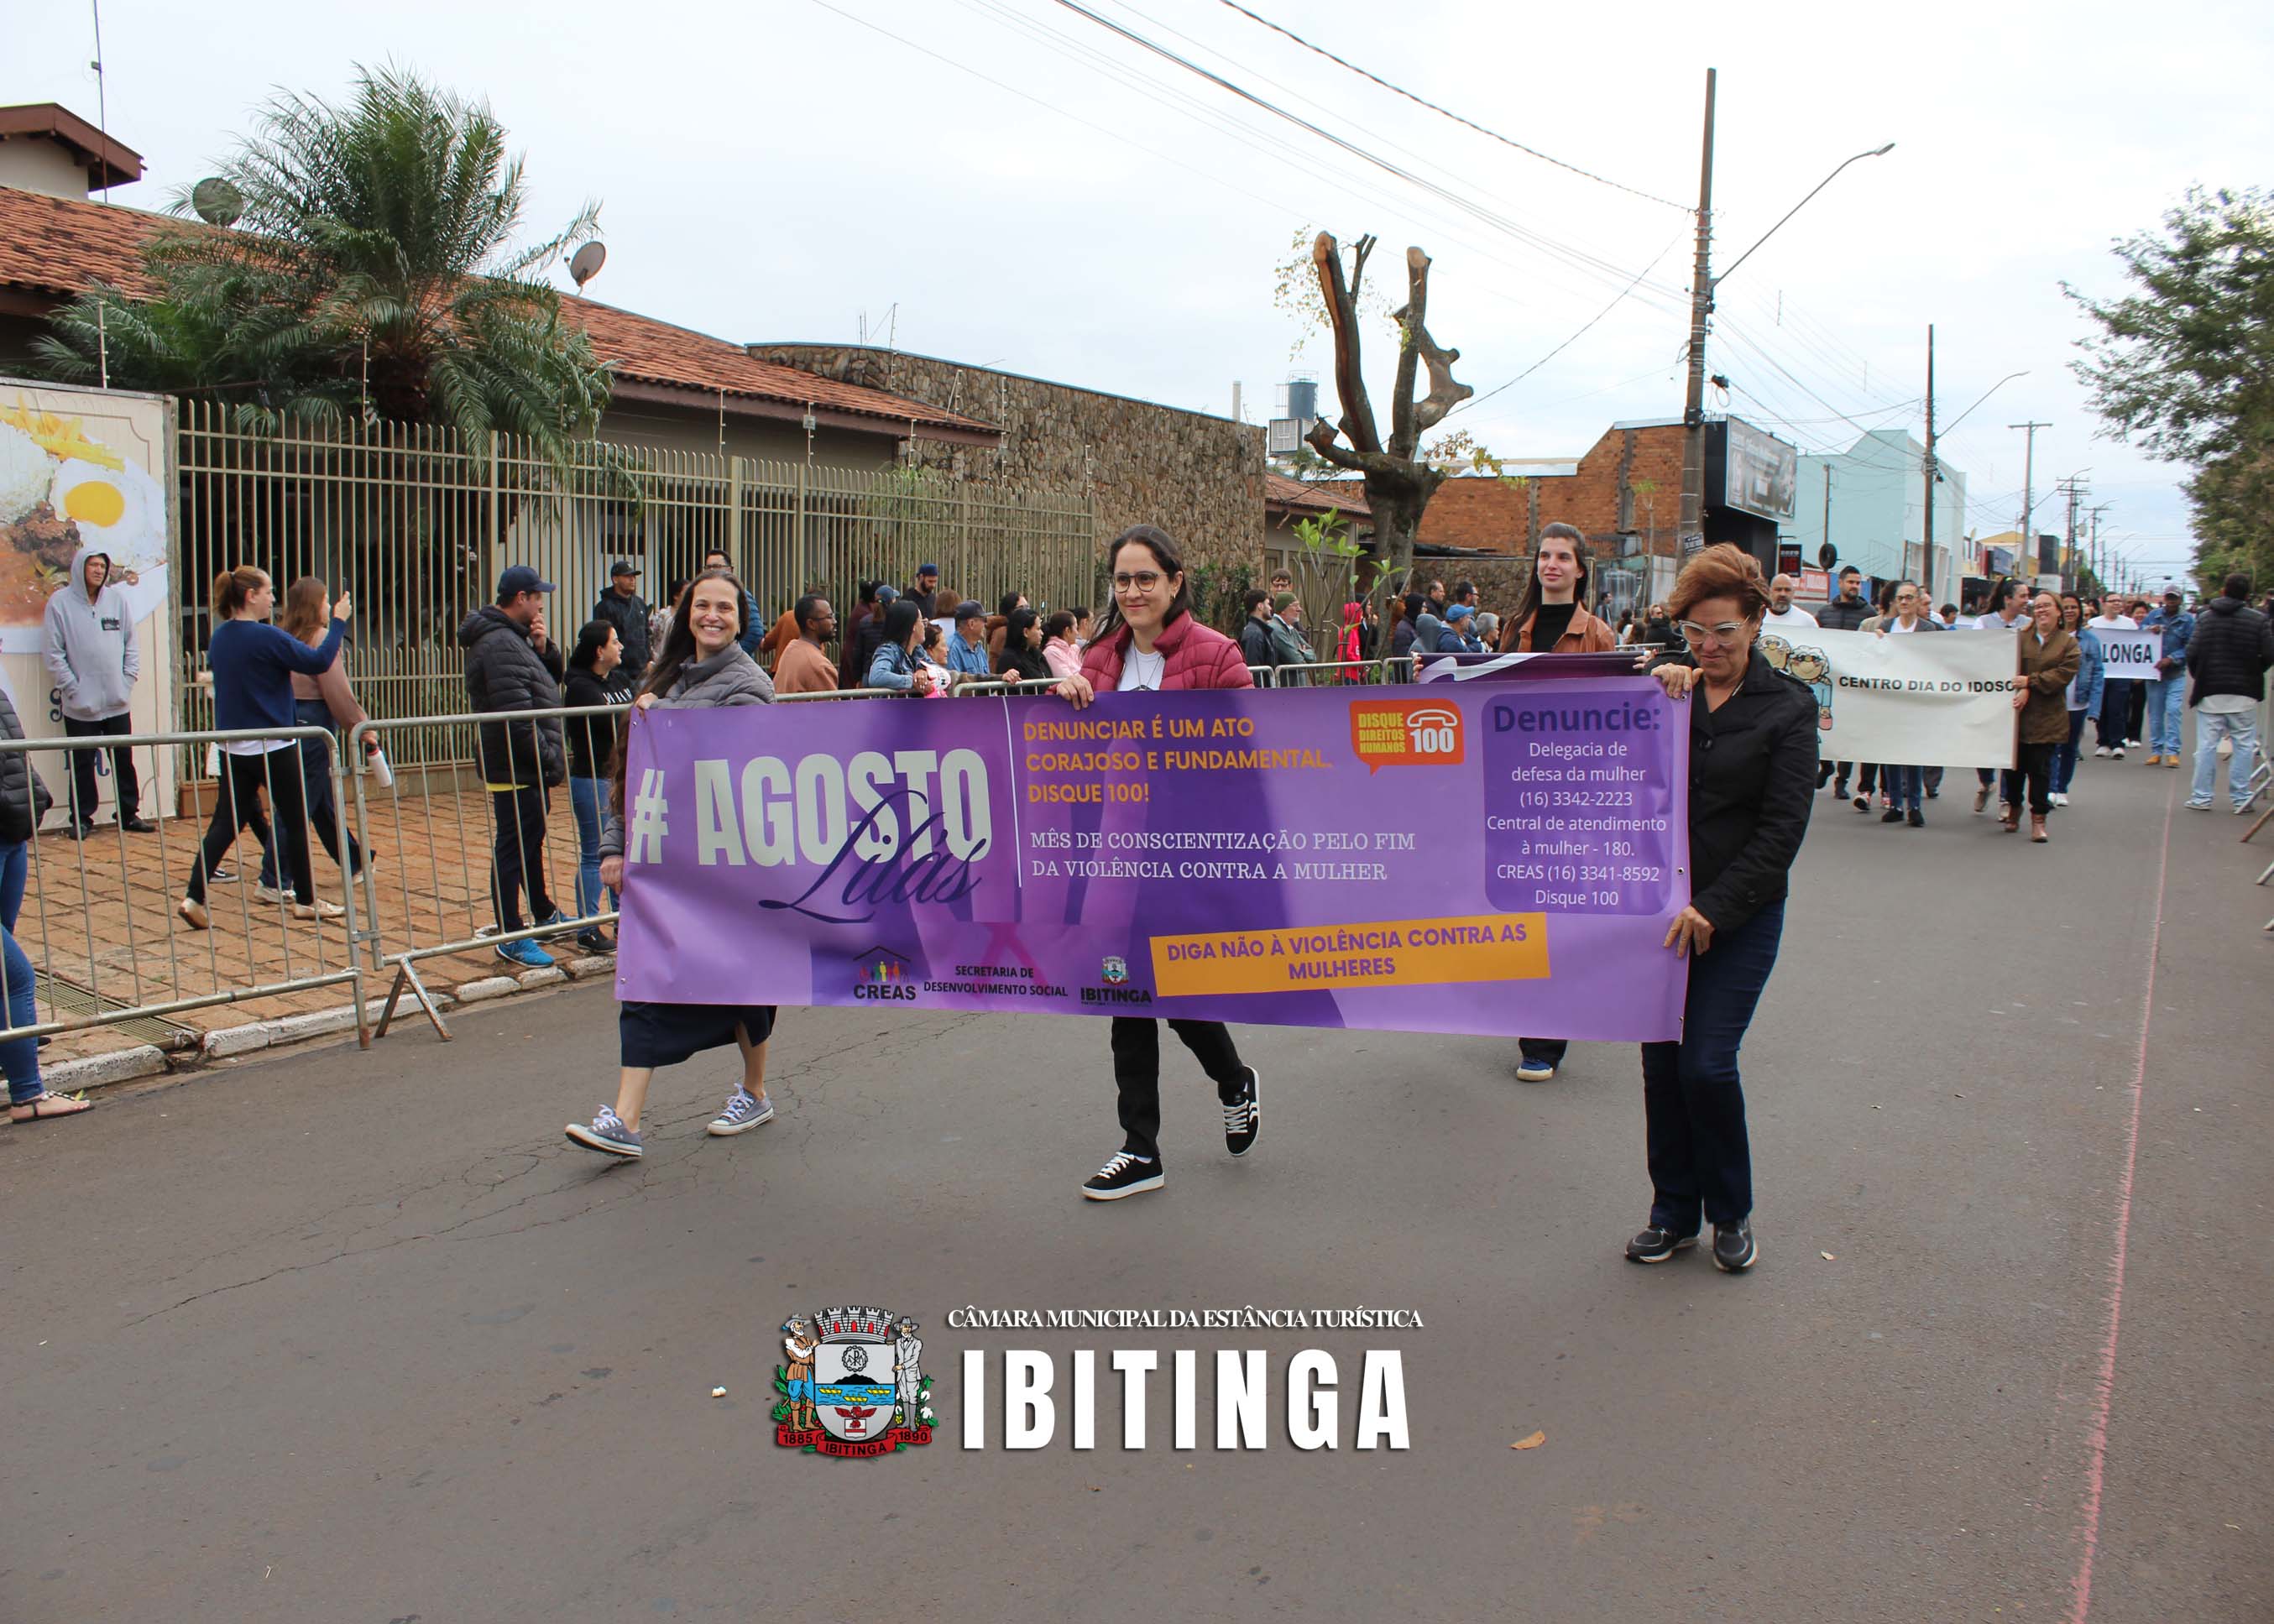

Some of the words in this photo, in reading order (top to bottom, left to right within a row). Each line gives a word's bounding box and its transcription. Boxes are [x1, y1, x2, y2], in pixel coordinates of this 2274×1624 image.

[2101, 643, 2153, 663] LONGA
[1839, 676, 1902, 691] CENTRO
[1908, 680, 1934, 692] DIA
[1940, 681, 1962, 692] DO
[1358, 713, 1404, 728] DISQUE
[1494, 702, 1661, 732] Denuncie:
[1023, 720, 1147, 741] DENUNCIAR
[1152, 713, 1163, 739] É
[1169, 718, 1205, 738] UM
[1210, 717, 1255, 737] ATO
[1359, 728, 1405, 741] DIREITOS
[1410, 728, 1455, 753] 100
[1529, 743, 1603, 760] Delegacia
[1607, 741, 1628, 756] de
[1026, 751, 1141, 772] CORAJOSO
[1147, 751, 1158, 770] E
[1511, 766, 1562, 781] defesa
[1566, 766, 1586, 781] da
[1590, 766, 1646, 781] mulher
[1028, 784, 1102, 803] DISQUE
[1107, 782, 1150, 802] 100!
[1520, 791, 1548, 808] (16)
[1553, 791, 1633, 807] 3342-2223
[629, 767, 669, 864] #
[693, 749, 992, 867] AGOSTO
[1487, 816, 1541, 831] Central
[1545, 816, 1565, 831] de
[1569, 817, 1666, 831] atendimento
[1030, 828, 1071, 849] MÊS
[1075, 833, 1102, 849] DE
[1107, 829, 1307, 854] CONSCIENTIZAÇÃO
[1313, 833, 1368, 850] PELO
[1374, 833, 1415, 850] FIM
[1521, 840, 1530, 855] à
[1534, 841, 1589, 855] mulher
[1603, 841, 1635, 856] 180.
[1032, 860, 1060, 876] DA
[1064, 856, 1174, 878] VIOLÊNCIA
[1179, 862, 1267, 879] CONTRA
[1272, 863, 1289, 880] A
[1294, 863, 1388, 880] MULHER
[1497, 864, 1544, 880] CREAS
[1548, 865, 1576, 882] (16)
[1580, 866, 1660, 881] 3341-8592
[1535, 890, 1587, 908] Disque
[1592, 891, 1618, 906] 100
[1168, 943, 1216, 960] DIGA
[1221, 936, 1264, 958] NÃO
[1270, 934, 1285, 956] À
[1289, 928, 1402, 954] VIOLÊNCIA
[1408, 926, 1494, 947] CONTRA
[1500, 923, 1527, 942] AS
[955, 965, 1017, 978] SECRETARIA
[1021, 968, 1034, 979] DE
[1289, 957, 1396, 979] MULHERES
[853, 984, 917, 1001] CREAS
[923, 980, 1027, 995] DESENVOLVIMENTO
[1030, 984, 1068, 997] SOCIAL
[1080, 987, 1153, 1003] IBITINGA
